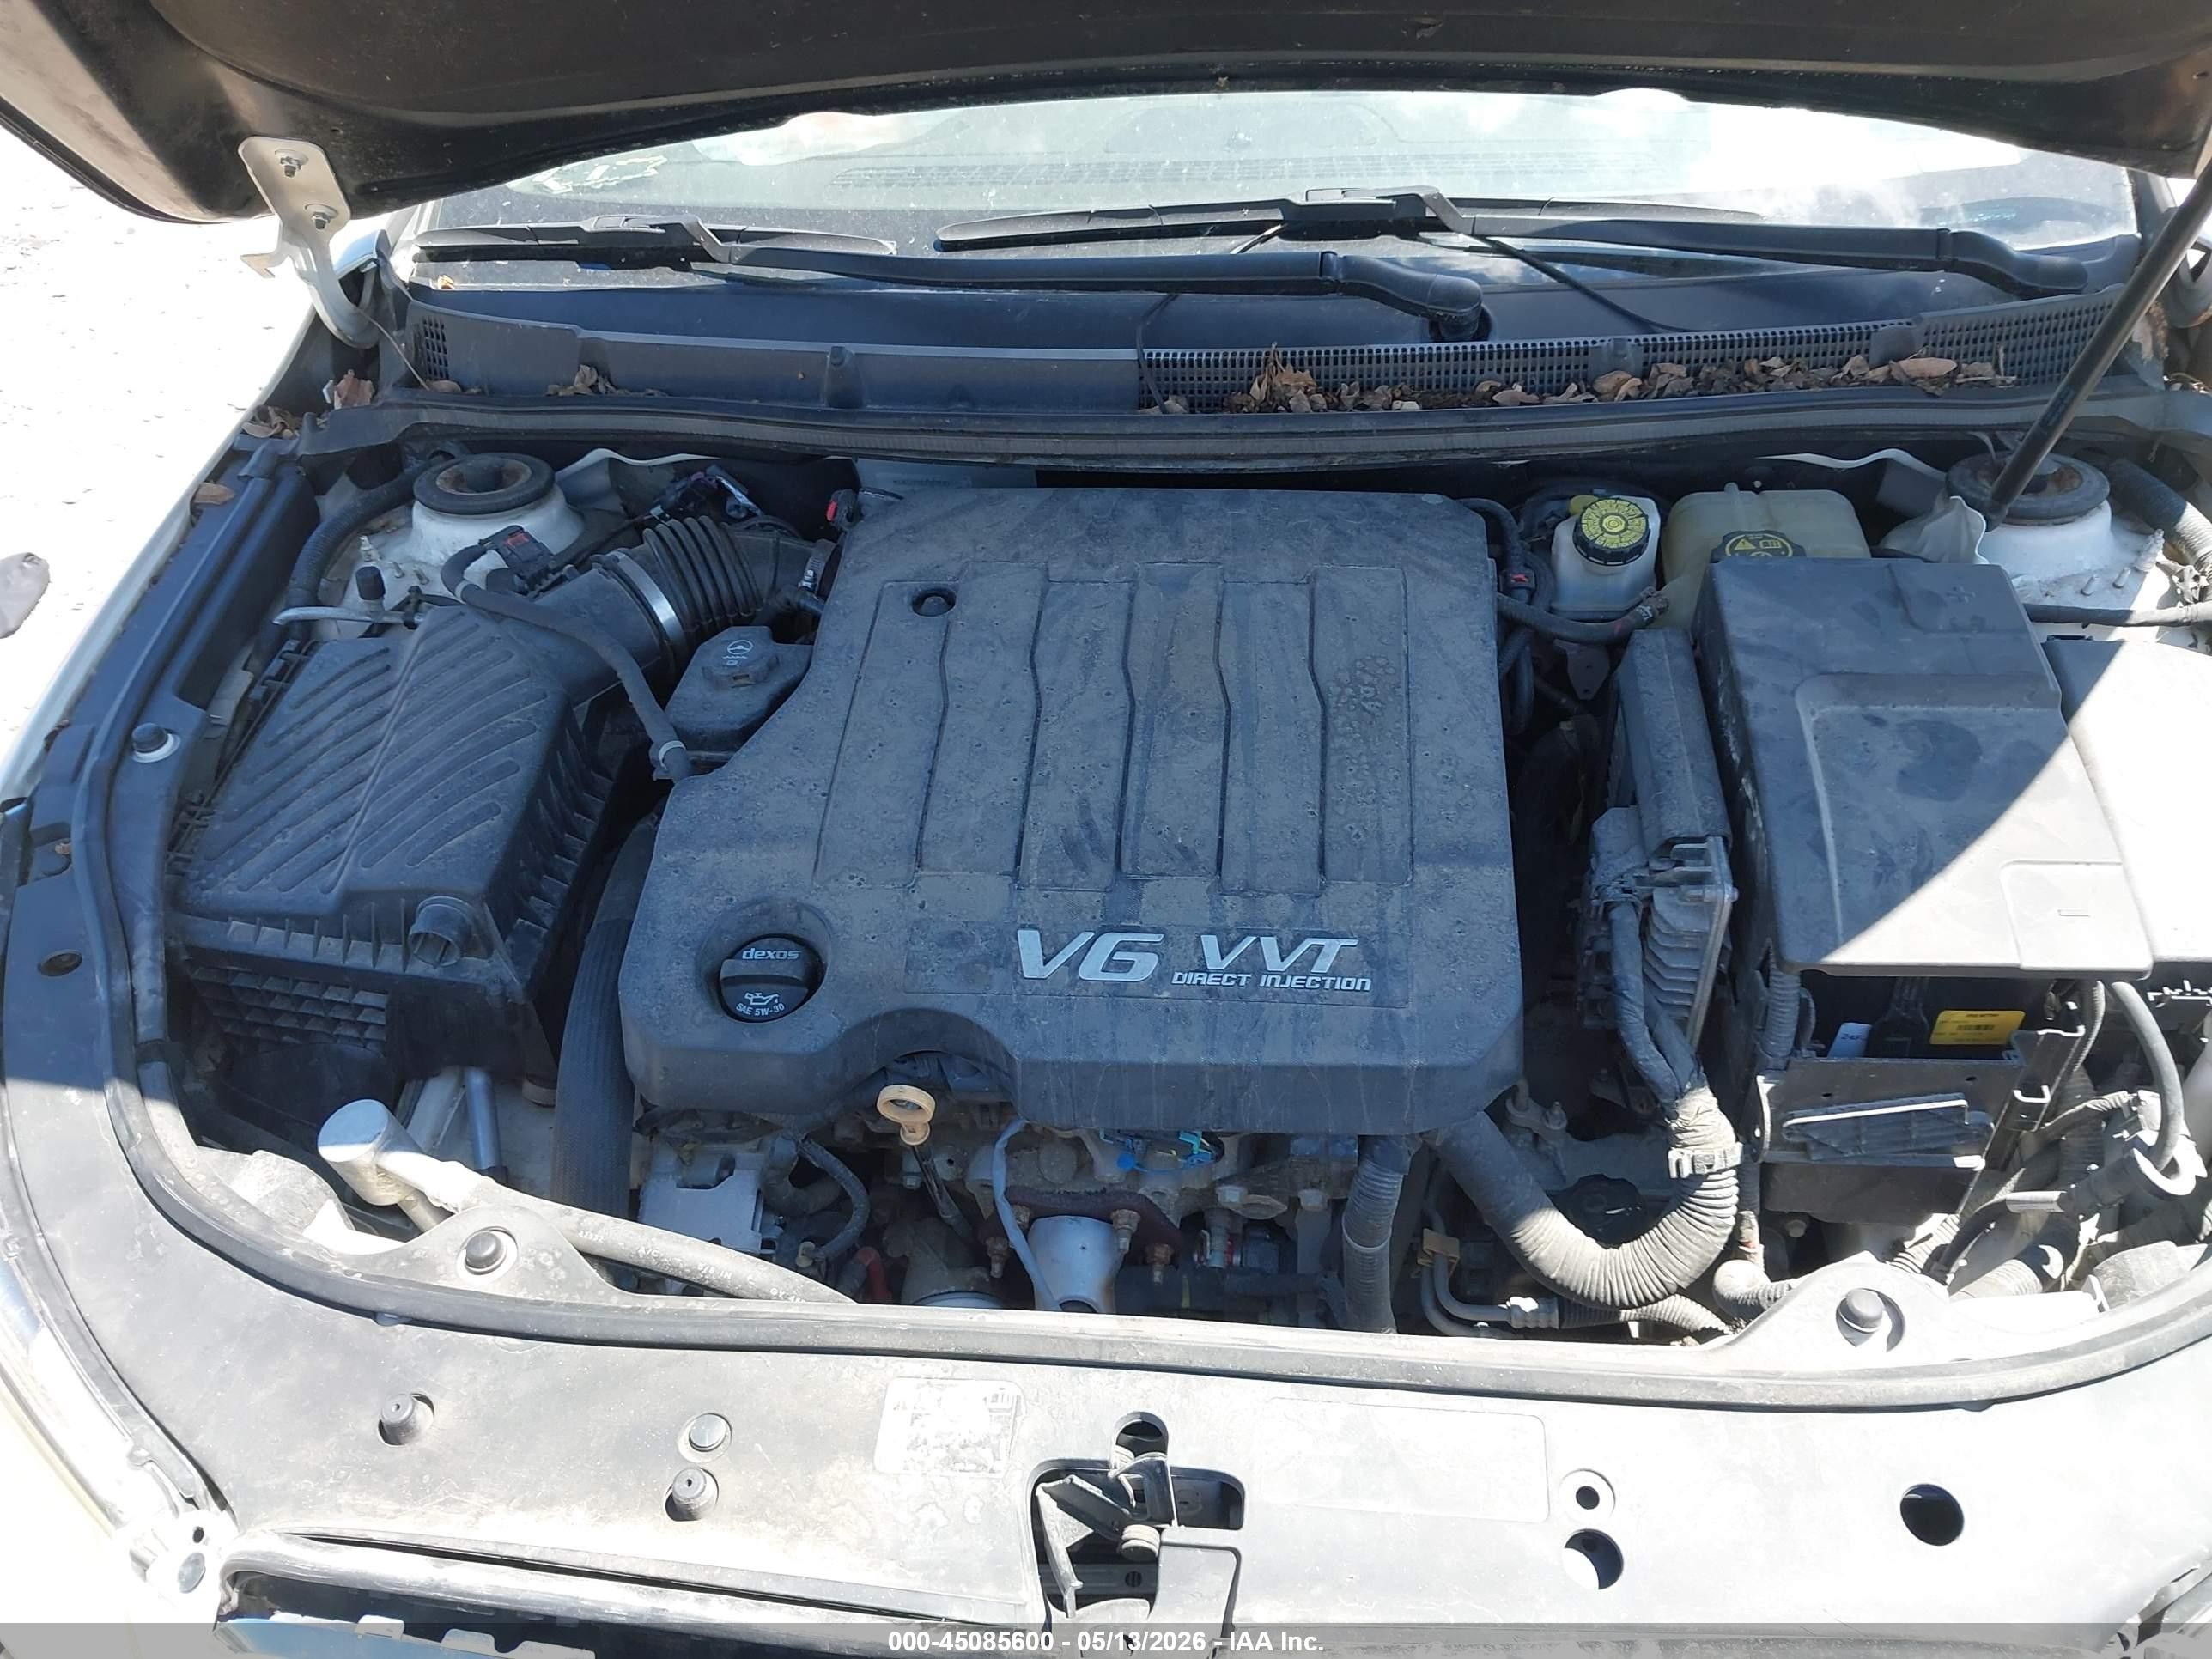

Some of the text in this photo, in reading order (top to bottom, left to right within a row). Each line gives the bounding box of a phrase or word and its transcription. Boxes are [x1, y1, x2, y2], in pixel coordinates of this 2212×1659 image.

[742, 948, 802, 960] dexos
[1017, 929, 1359, 981] V6 VVT
[1172, 971, 1372, 992] DIRECT INJECTION
[736, 1002, 785, 1017] SAE 5W-30
